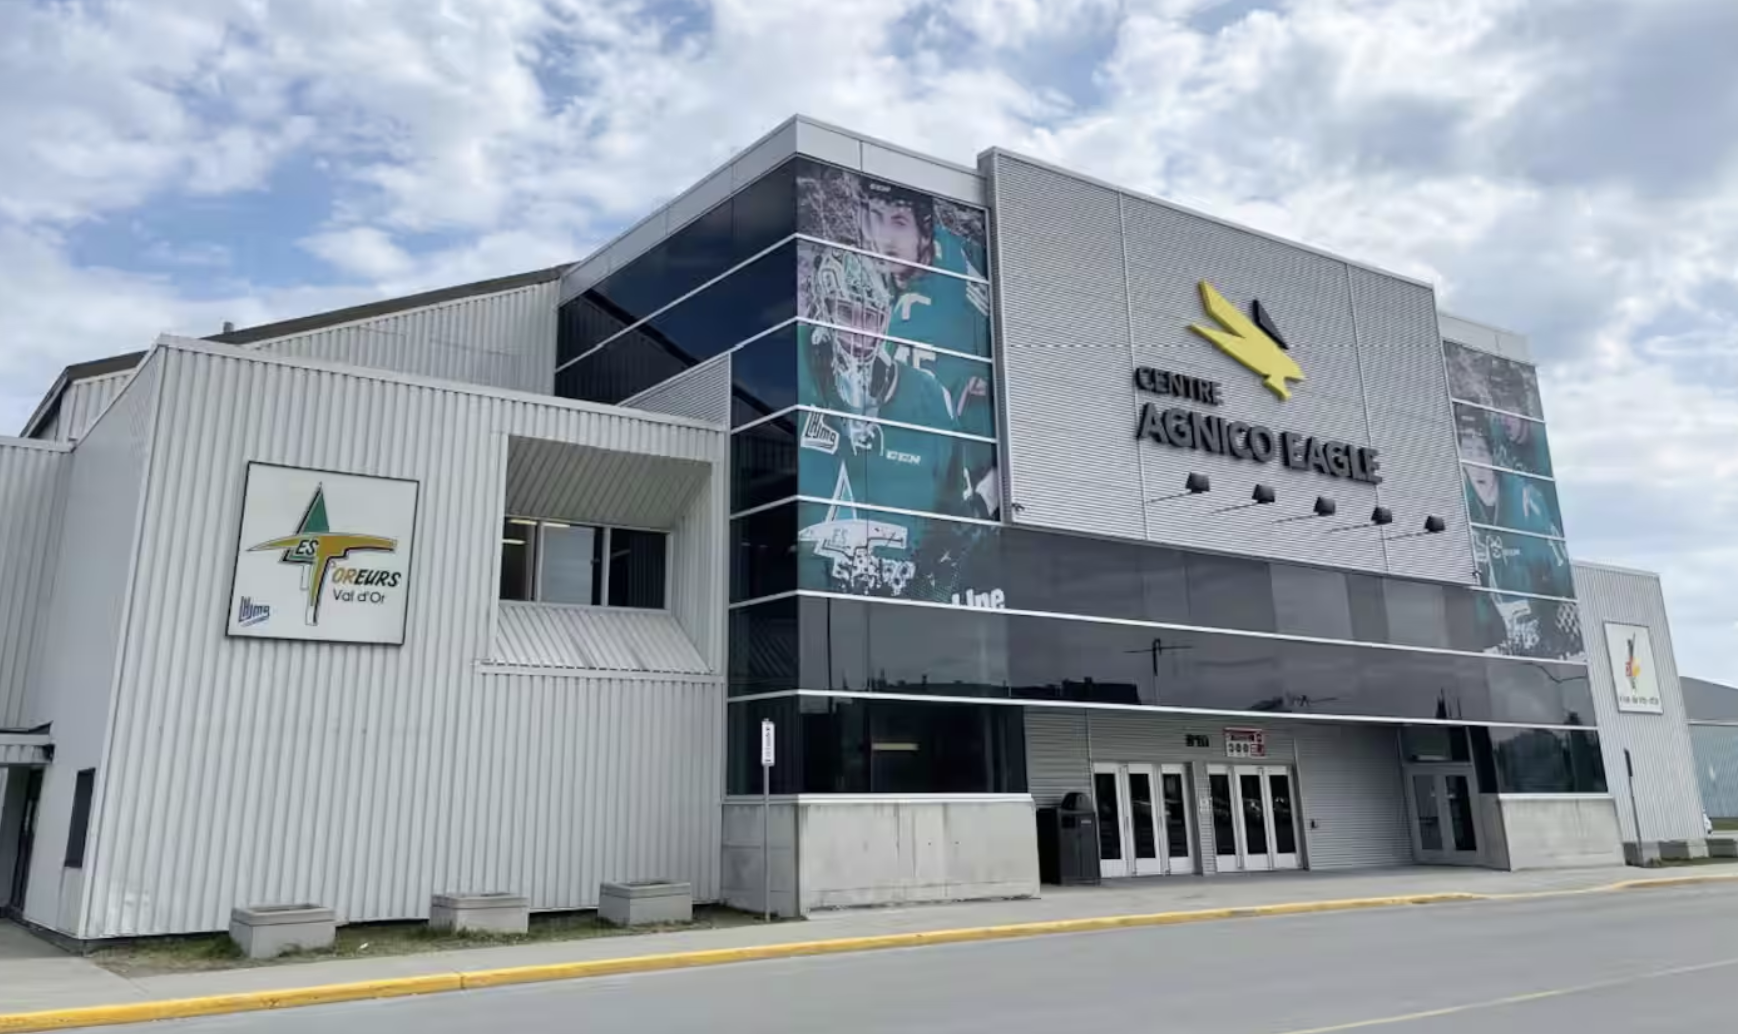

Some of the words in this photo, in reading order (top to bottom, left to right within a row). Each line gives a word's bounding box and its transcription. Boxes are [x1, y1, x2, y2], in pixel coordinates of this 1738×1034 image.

[1135, 366, 1223, 405] CENTRE
[1137, 402, 1275, 463] AGNICO
[1281, 431, 1382, 484] EAGLE
[333, 588, 354, 602] Val
[357, 590, 385, 604] d'Or
